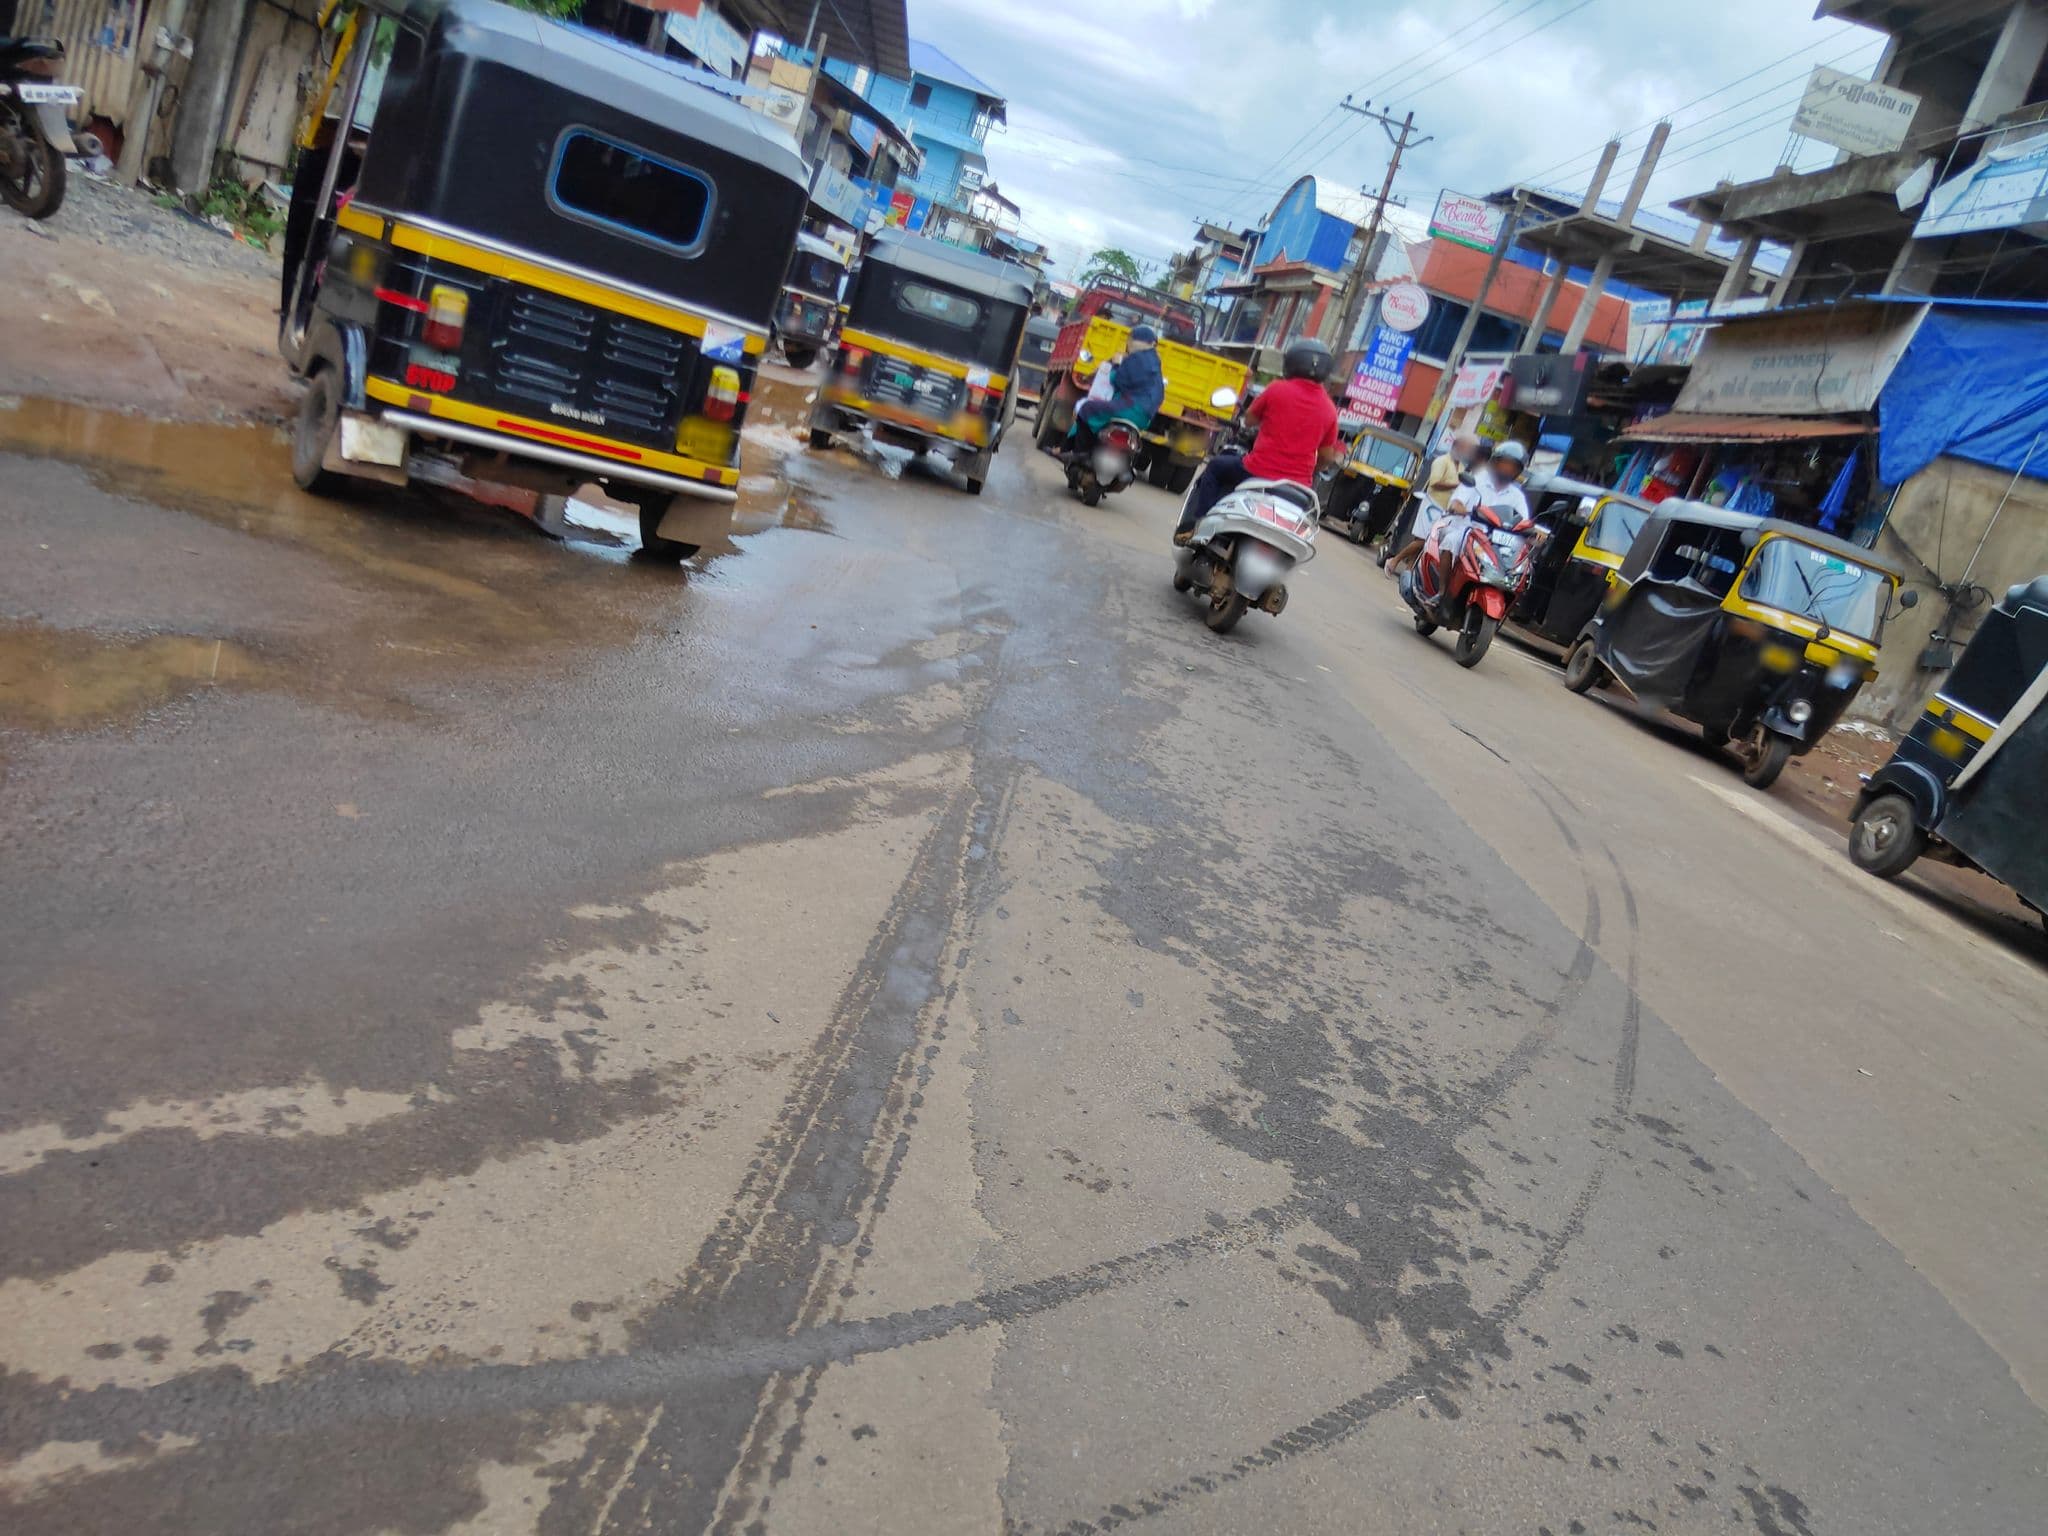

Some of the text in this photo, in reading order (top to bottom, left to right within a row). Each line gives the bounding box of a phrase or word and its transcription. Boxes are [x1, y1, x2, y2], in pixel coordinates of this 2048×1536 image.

[1378, 328, 1410, 347] FANCY
[1378, 343, 1401, 359] GIFT
[1373, 353, 1398, 371] TOYS
[1358, 362, 1403, 386] FLOWERS
[1359, 375, 1393, 396] LADIES
[1345, 384, 1398, 411] INNERWEAR
[1353, 401, 1381, 417] GOLD
